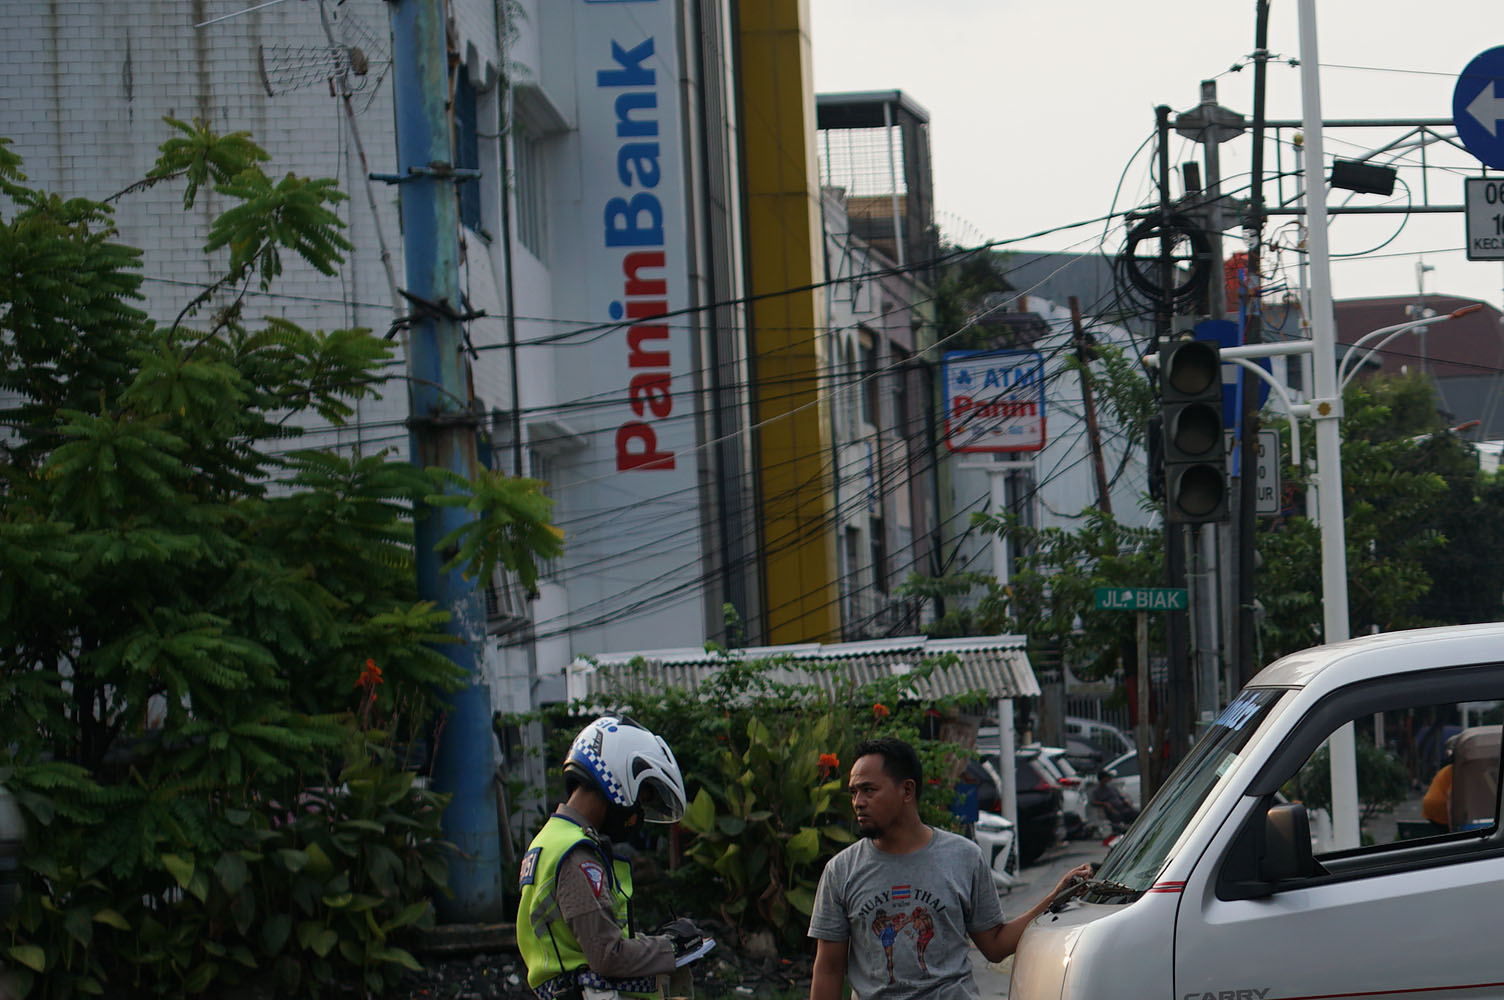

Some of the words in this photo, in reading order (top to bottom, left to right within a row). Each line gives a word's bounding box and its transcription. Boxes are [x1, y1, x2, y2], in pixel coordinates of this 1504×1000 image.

[983, 367, 1036, 390] ATM
[953, 395, 1037, 418] Panin
[1136, 591, 1180, 609] BIAK
[858, 890, 890, 920] MUAY
[914, 888, 947, 913] THAI
